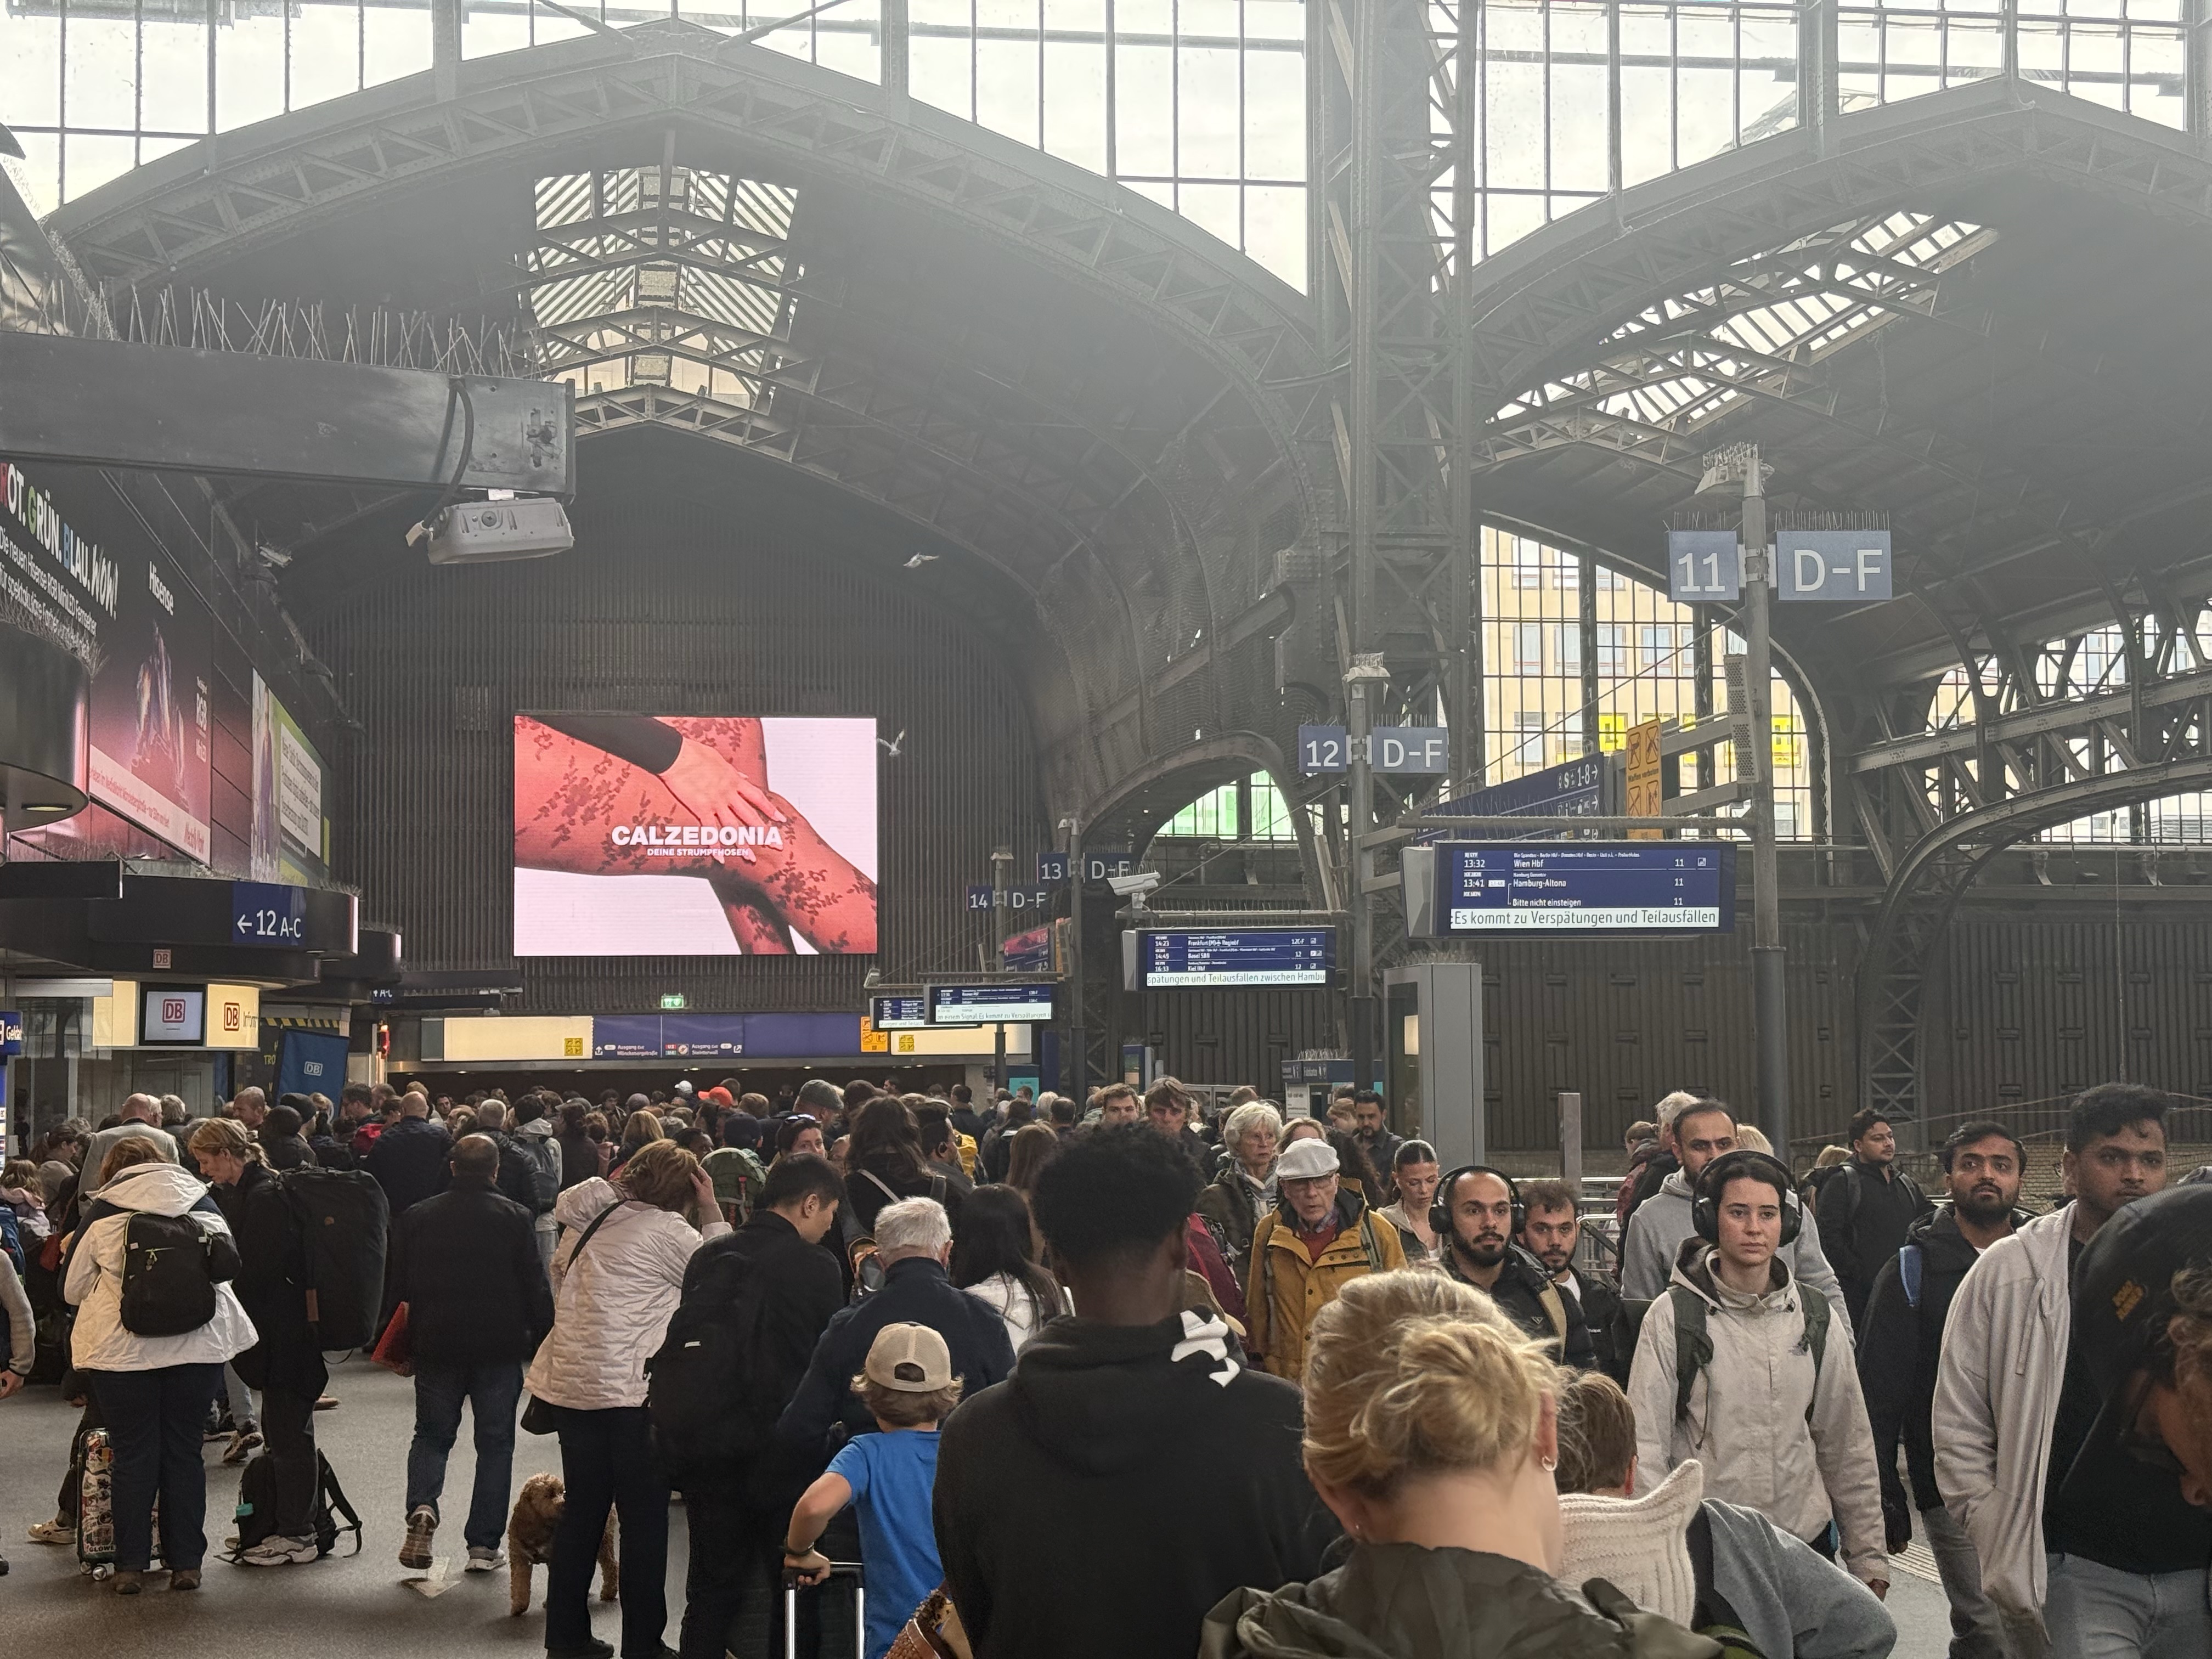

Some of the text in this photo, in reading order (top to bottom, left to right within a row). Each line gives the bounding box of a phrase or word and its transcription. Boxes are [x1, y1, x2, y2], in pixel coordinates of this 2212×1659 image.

[29, 486, 62, 563] GRÜN.
[64, 523, 90, 592] BLAU.
[10, 540, 27, 573] neuen
[28, 551, 47, 591] Hisense
[1678, 552, 1725, 592] 11
[1794, 549, 1883, 591] D-F
[149, 561, 174, 616] Hisense
[1306, 740, 1339, 767] 12
[1384, 739, 1443, 768] D-F
[1577, 764, 1590, 787] 1-8
[612, 826, 783, 846] CALZEDONIA
[647, 848, 749, 856] DEINE STRUMPFHOSEN
[1041, 863, 1062, 879] 13
[1092, 861, 1130, 879] D-F
[1464, 860, 1485, 868] 13:32
[1532, 860, 1544, 868] Hbf
[1675, 859, 1684, 867] 11
[1463, 879, 1485, 888] 13:41
[1513, 879, 1566, 889] Hamburg-Altona
[1674, 878, 1684, 886] 11
[970, 894, 988, 908] 14
[1013, 892, 1046, 909] D-F
[1530, 898, 1546, 906] nicht
[1547, 899, 1581, 908] einsteigen
[1674, 898, 1683, 906] 11
[256, 910, 302, 938] 12 A-C
[1454, 909, 1716, 927] Es kommt zu Verspätungen und Teilausfällen
[156, 953, 168, 964] DB
[1147, 972, 1325, 985] spätungen und Teilausfällen zwischen Hambu
[165, 1003, 183, 1019] DB
[226, 1007, 238, 1026] DB
[306, 1063, 320, 1074] DB
